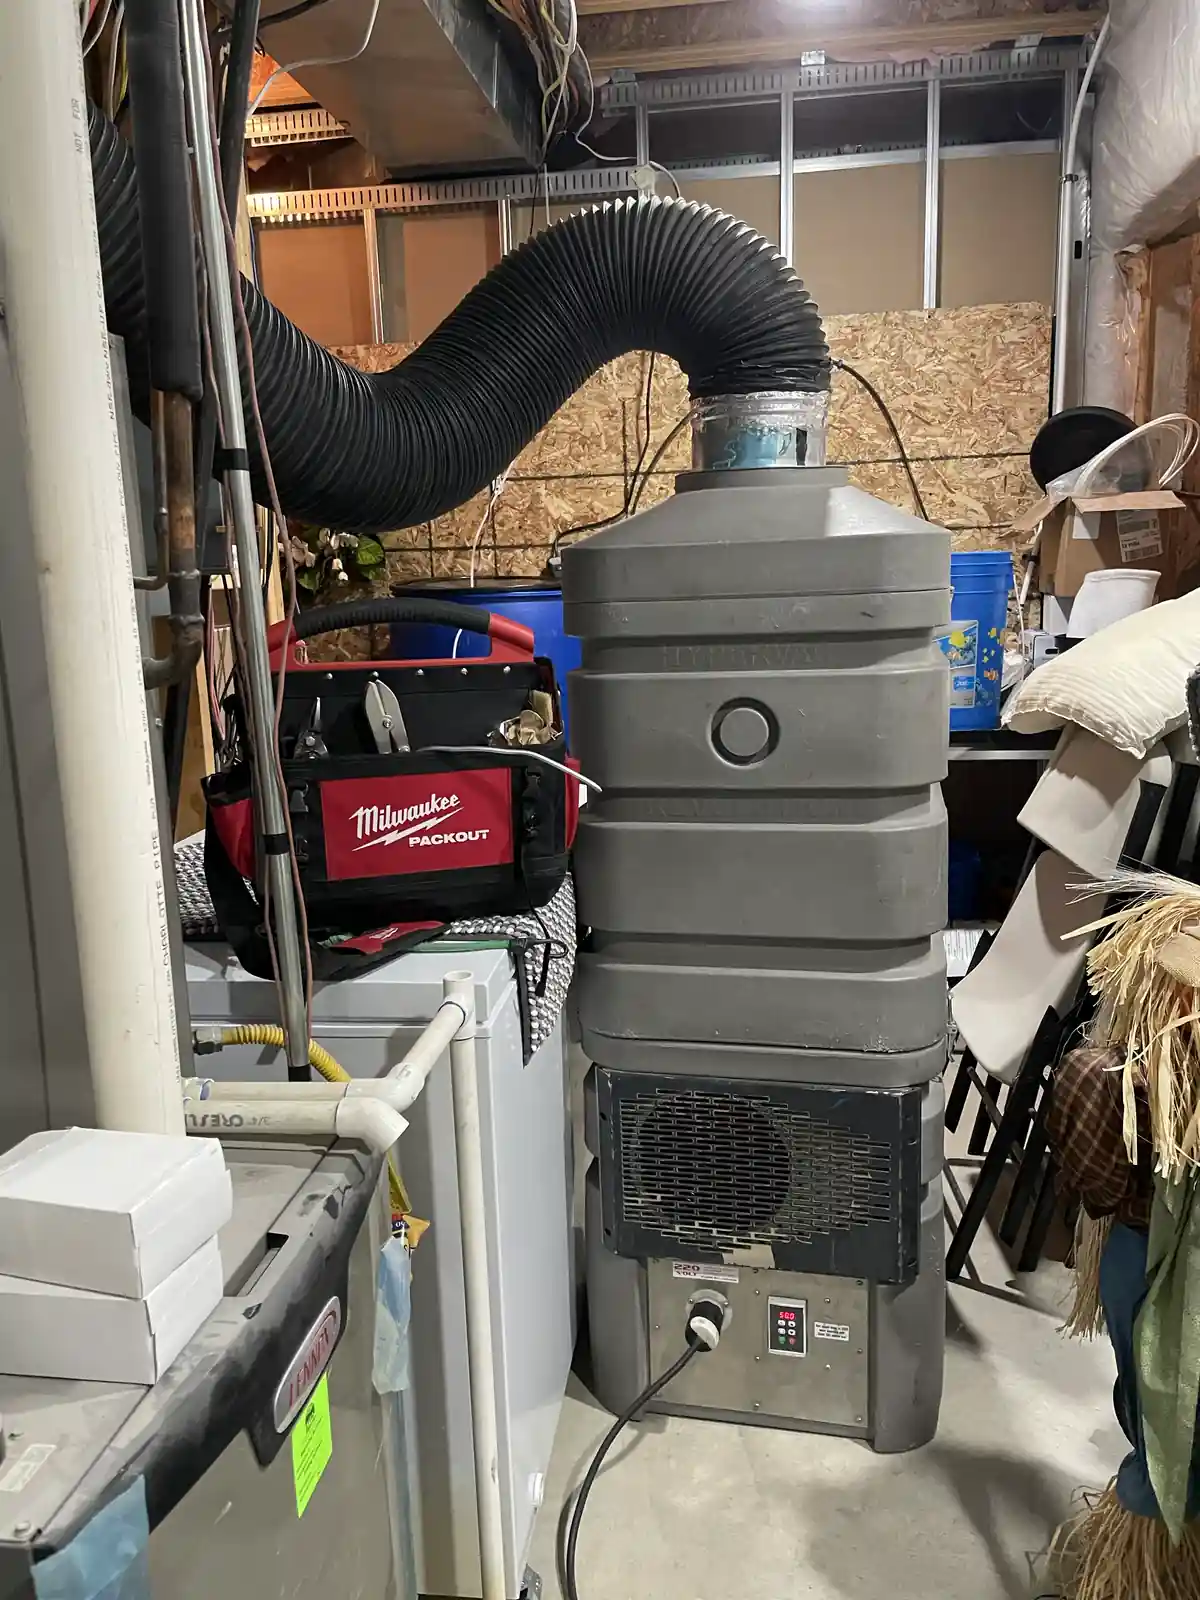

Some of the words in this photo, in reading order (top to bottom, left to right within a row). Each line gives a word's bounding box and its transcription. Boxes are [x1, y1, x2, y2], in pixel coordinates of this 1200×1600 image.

[71, 98, 82, 121] FOR
[73, 133, 84, 153] NOT
[348, 793, 460, 839] Milwaukee
[408, 829, 490, 847] PACKOUT
[674, 1263, 700, 1271] 220
